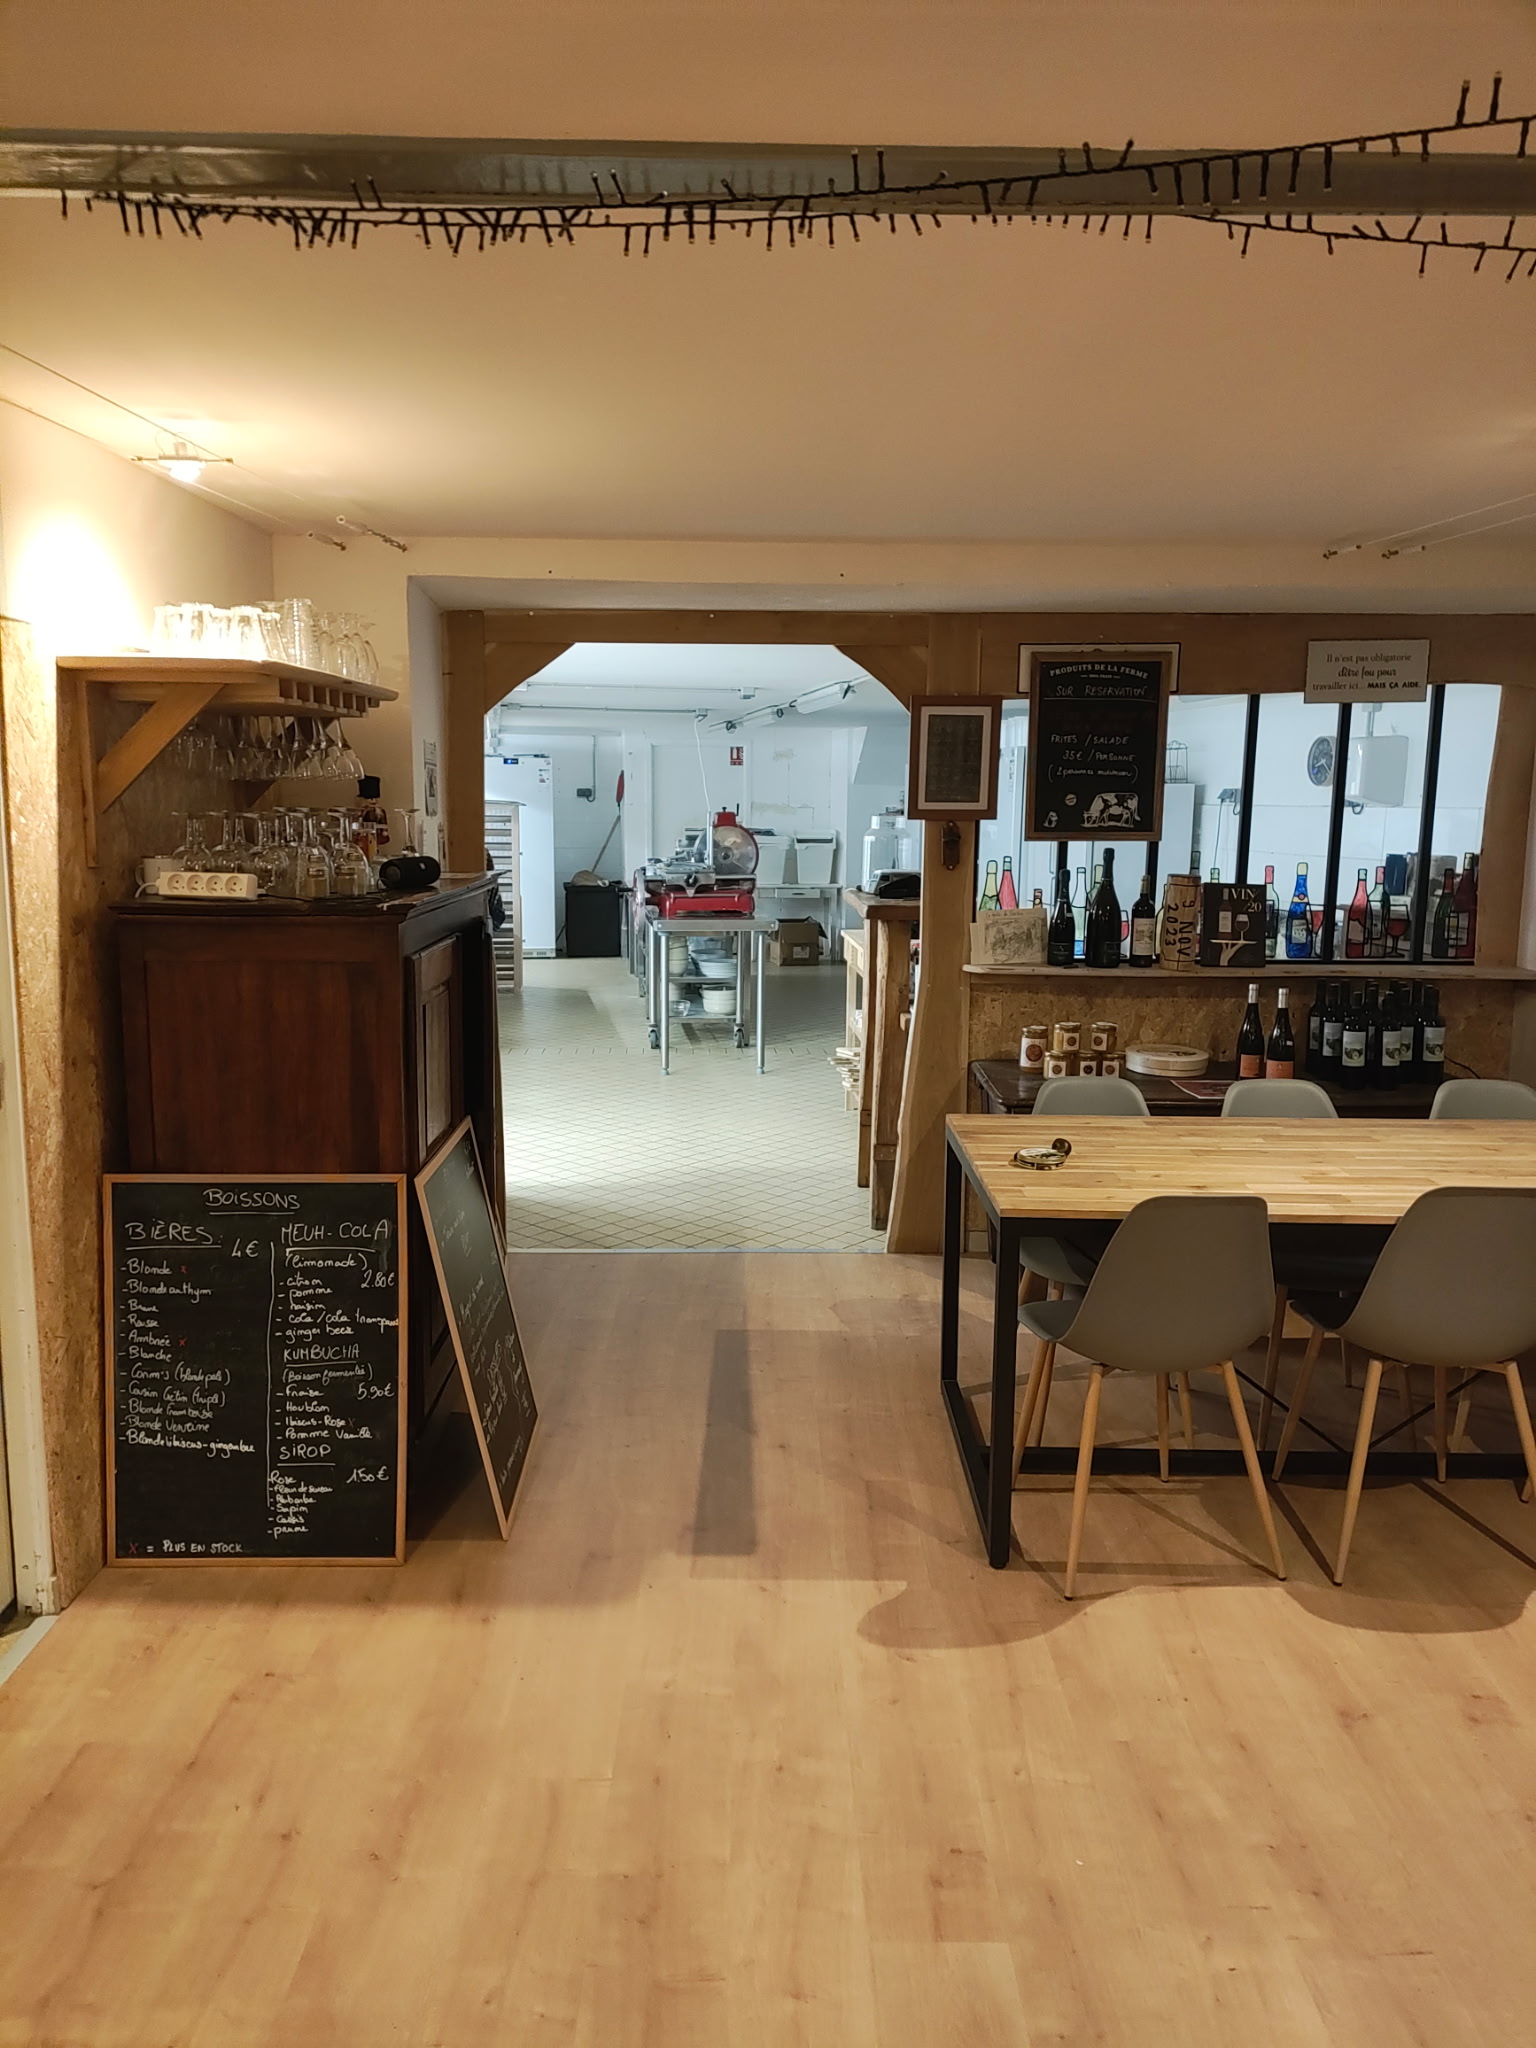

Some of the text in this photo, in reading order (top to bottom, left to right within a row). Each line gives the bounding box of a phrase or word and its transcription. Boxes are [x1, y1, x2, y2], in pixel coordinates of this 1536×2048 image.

[1356, 655, 1369, 665] pas
[1049, 663, 1092, 677] PRODUITS
[1108, 664, 1118, 672] LA
[1120, 666, 1149, 679] FERME
[1361, 666, 1375, 680] fou
[1377, 669, 1397, 680] pour
[1056, 684, 1148, 697] SUR RESERVATION
[1312, 682, 1347, 691] travailler
[1389, 682, 1399, 690] ÇA
[1062, 750, 1083, 761] 35€
[1165, 903, 1180, 947] 2023
[1176, 920, 1194, 958] NOV
[203, 1188, 301, 1210] BOISSONS
[339, 1219, 389, 1241] COLA
[231, 1238, 260, 1258] 4€
[126, 1258, 172, 1275] Blonde
[283, 1343, 361, 1363] KUMBUCHA
[279, 1443, 332, 1461] SIROP
[162, 1539, 186, 1553] PLUS
[190, 1543, 206, 1553] EN
[210, 1542, 243, 1554] STOCK
